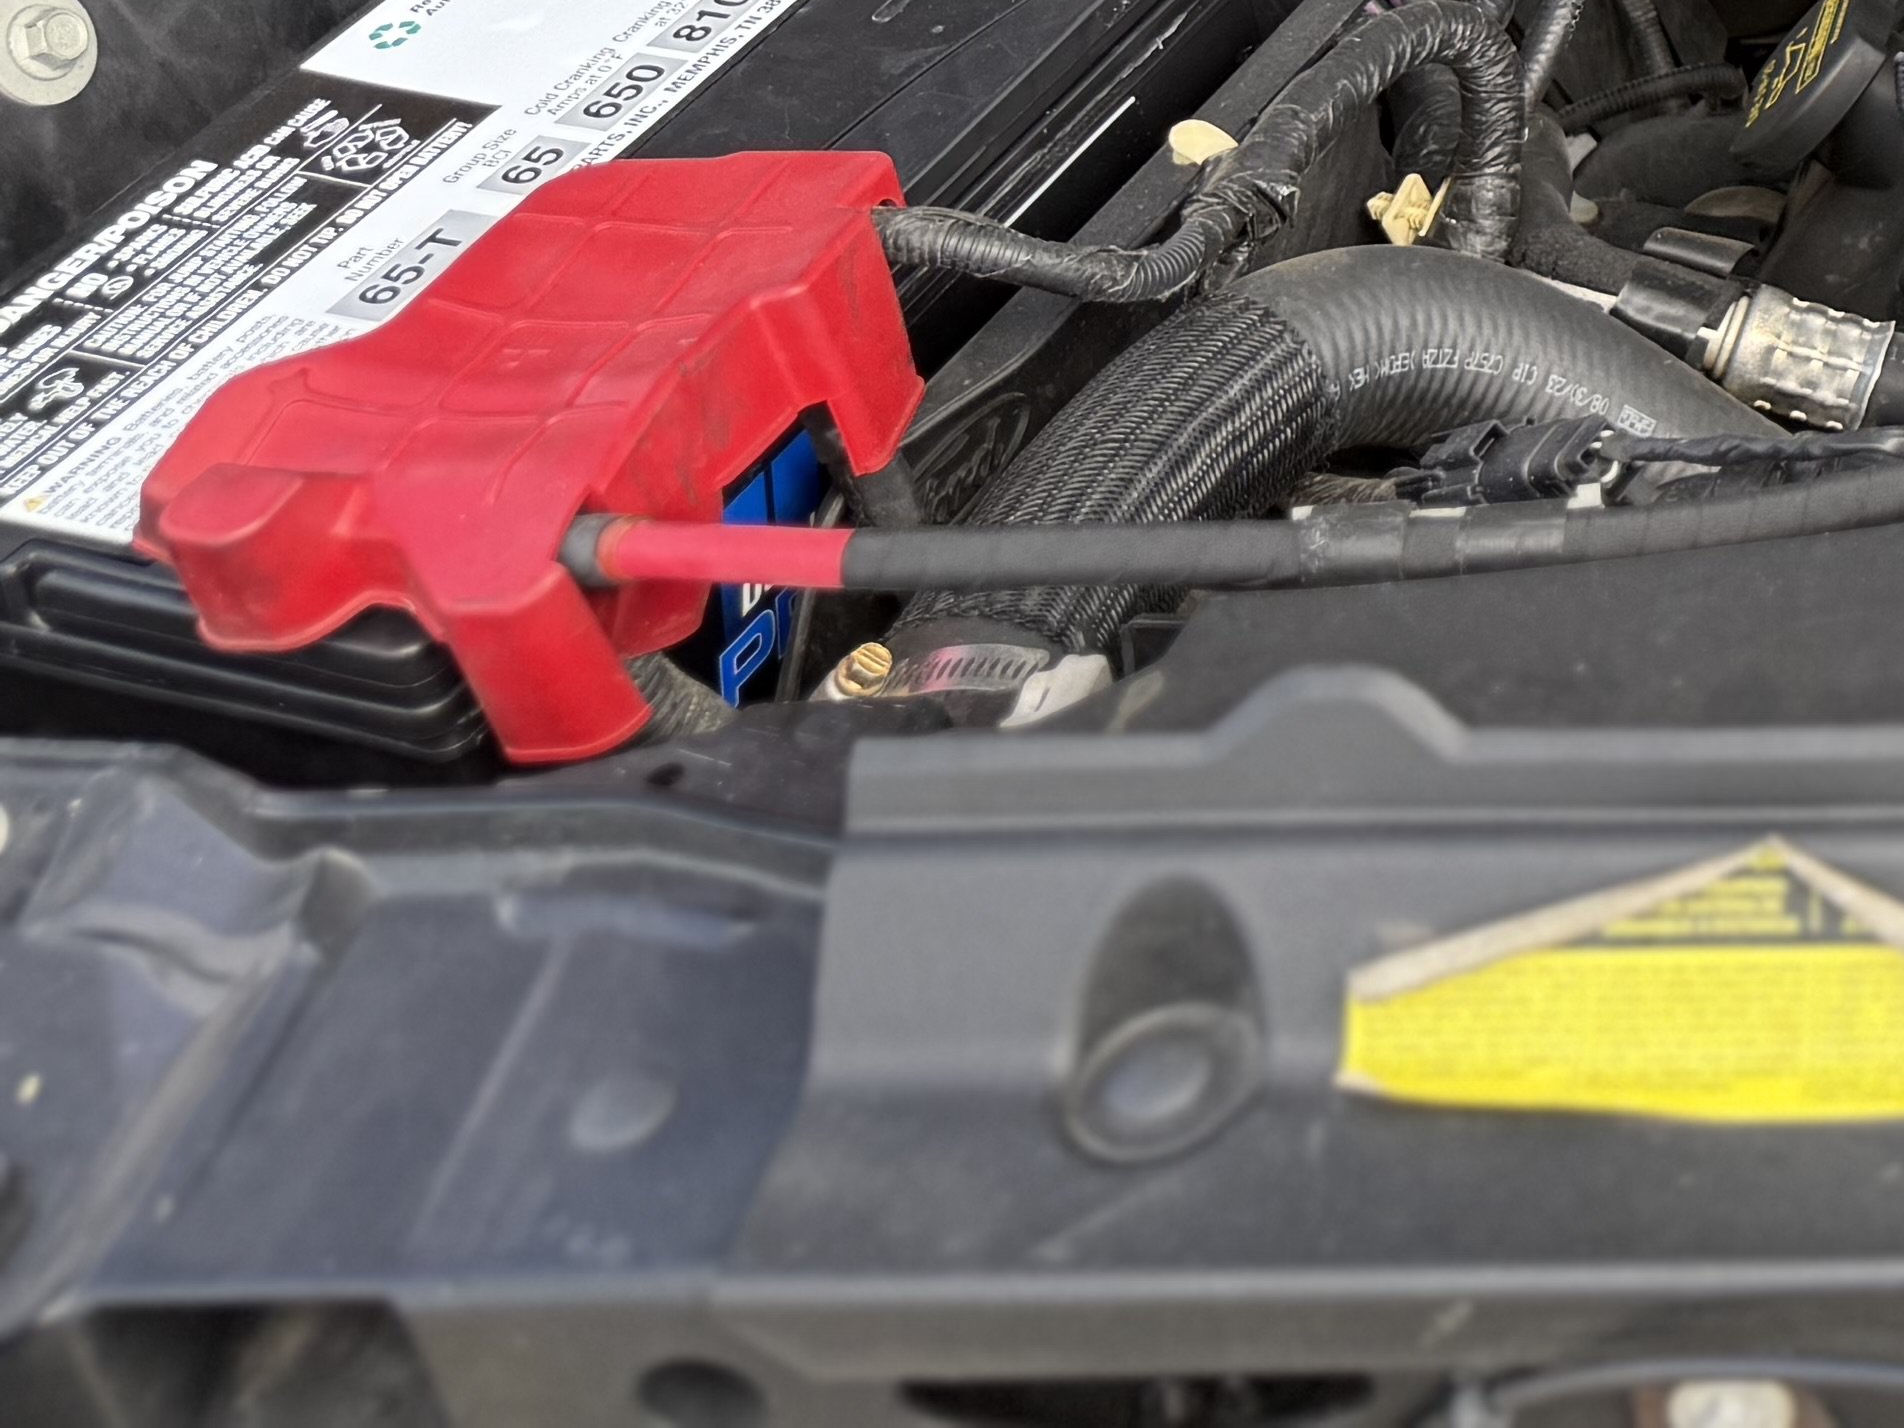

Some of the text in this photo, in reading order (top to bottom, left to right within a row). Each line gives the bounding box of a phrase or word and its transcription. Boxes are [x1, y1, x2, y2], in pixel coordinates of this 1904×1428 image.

[612, 0, 671, 42] Cranking
[654, 16, 670, 27] at
[664, 35, 742, 92] MEMPHIS,
[734, 15, 761, 29] TN
[524, 47, 615, 114] Cold Cranking
[546, 87, 586, 115] Amps
[584, 74, 601, 84] at
[583, 65, 663, 117] 650
[442, 152, 486, 183] Group
[481, 128, 516, 150] Size
[481, 149, 511, 167] BCI
[502, 146, 562, 183] 65
[336, 247, 372, 268] Part
[344, 238, 402, 281] Number
[359, 229, 459, 303] 65-T
[66, 273, 107, 297] NO
[142, 282, 174, 301] FOR
[37, 439, 74, 464] OUT
[68, 422, 94, 439] OF
[90, 398, 129, 419] THE
[120, 360, 175, 397] REACH
[168, 342, 193, 359] OF
[261, 267, 290, 284] DO
[282, 244, 316, 267] NOT
[44, 437, 120, 493] WARNING
[186, 346, 233, 380] battery
